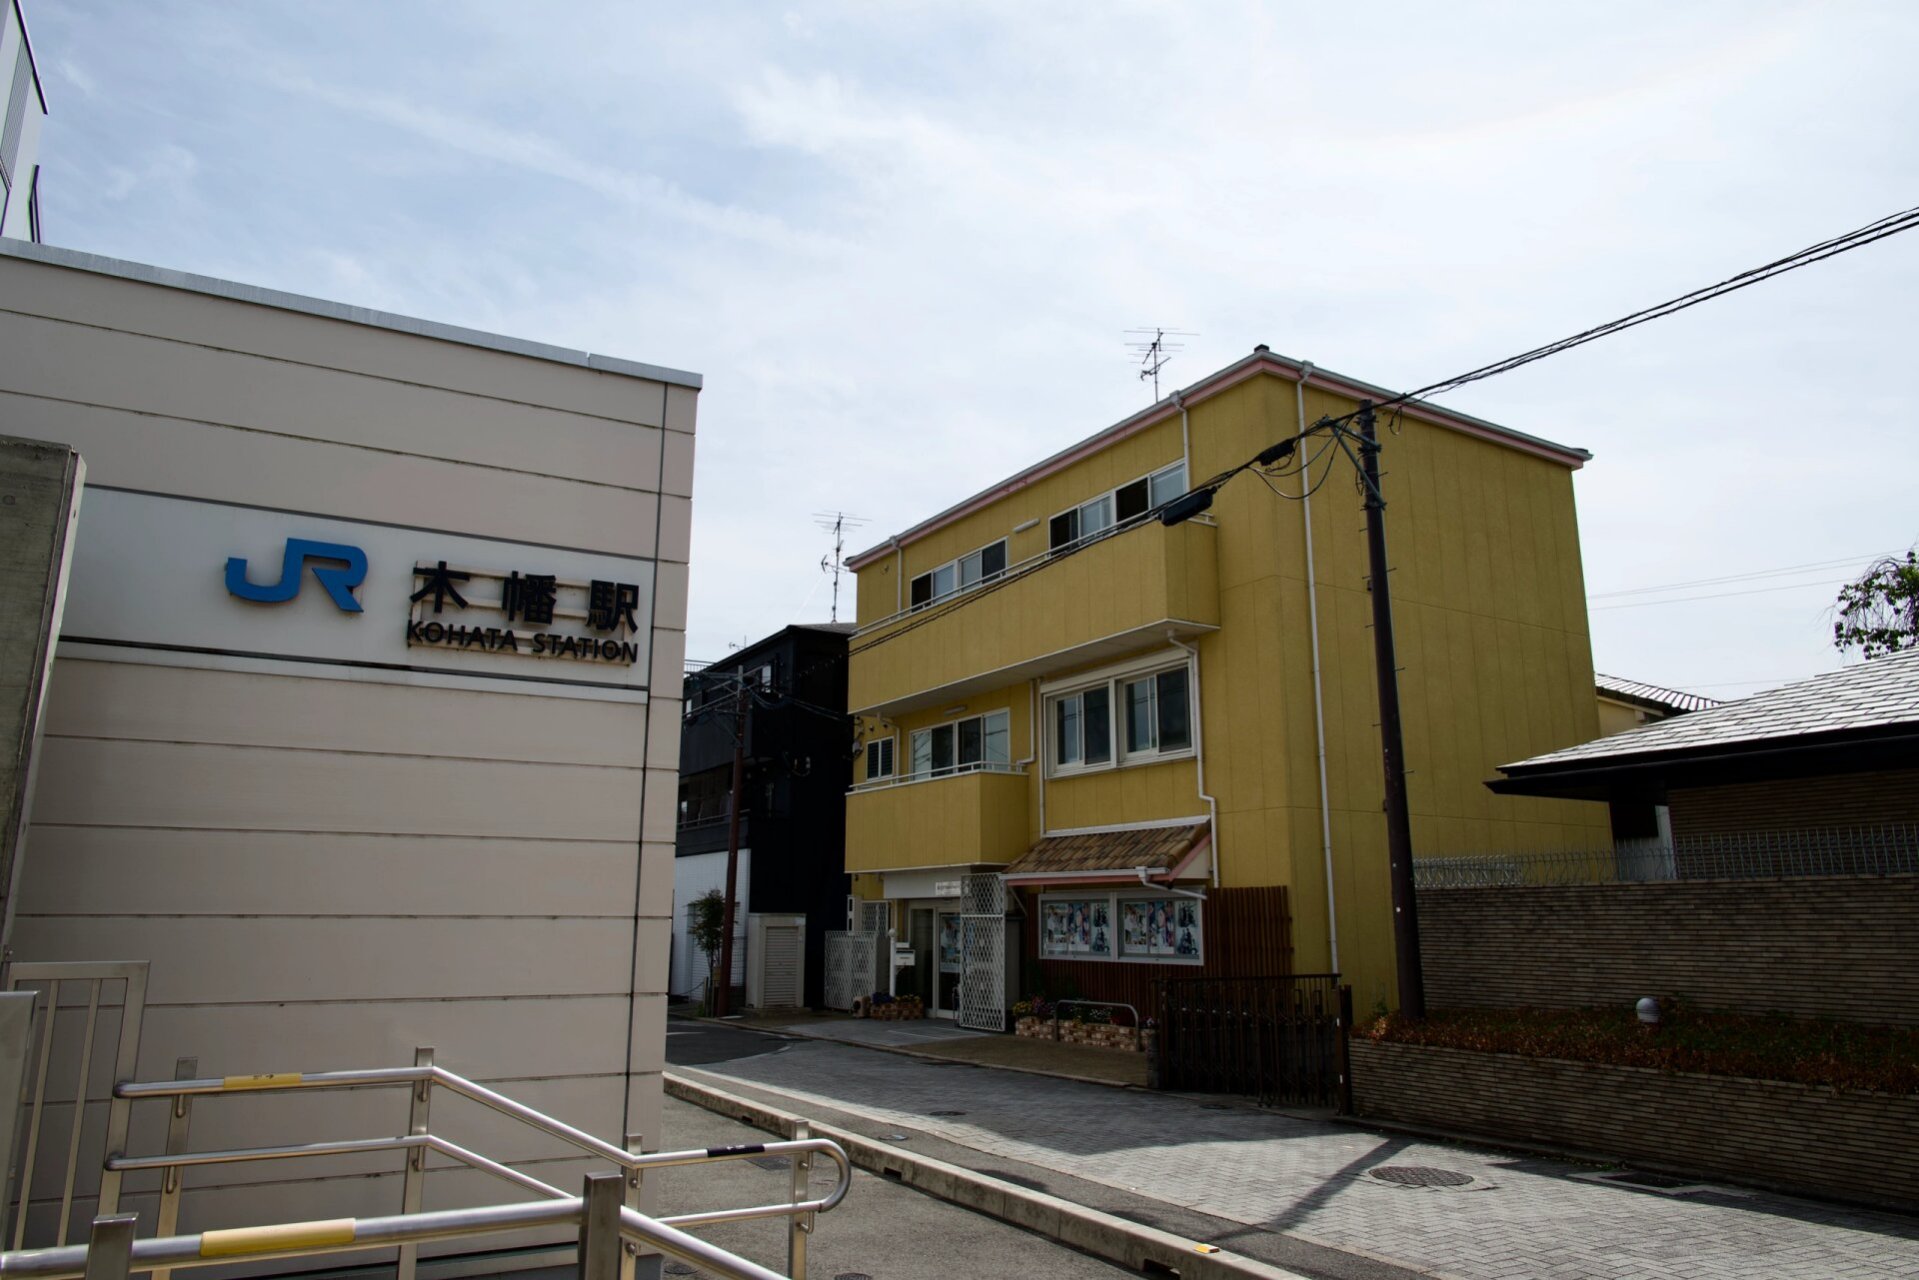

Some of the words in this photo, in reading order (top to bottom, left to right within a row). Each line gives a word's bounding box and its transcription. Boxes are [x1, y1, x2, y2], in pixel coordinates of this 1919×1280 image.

[225, 538, 367, 612] JR
[410, 561, 639, 633] 木幡駅
[407, 620, 518, 651] KOHATA
[532, 633, 638, 662] STATION
